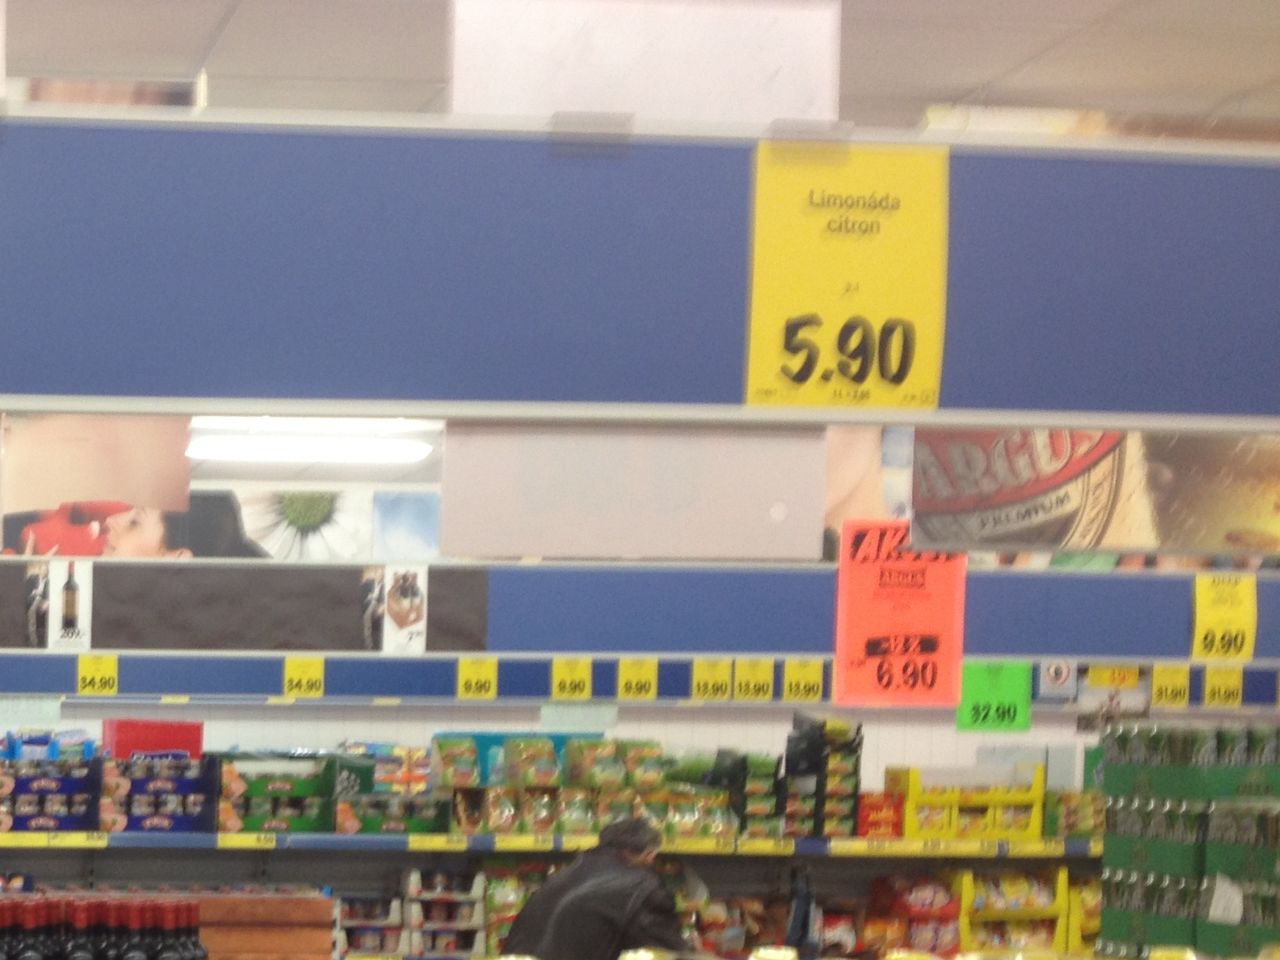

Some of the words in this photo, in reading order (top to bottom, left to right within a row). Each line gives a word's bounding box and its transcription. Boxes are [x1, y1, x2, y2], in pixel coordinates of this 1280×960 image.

[809, 189, 901, 211] Limonáda
[826, 216, 881, 235] citron
[780, 312, 916, 386] 5.90
[79, 675, 116, 691] 34.90
[876, 659, 939, 690] 6.90
[286, 677, 322, 693] 34.90
